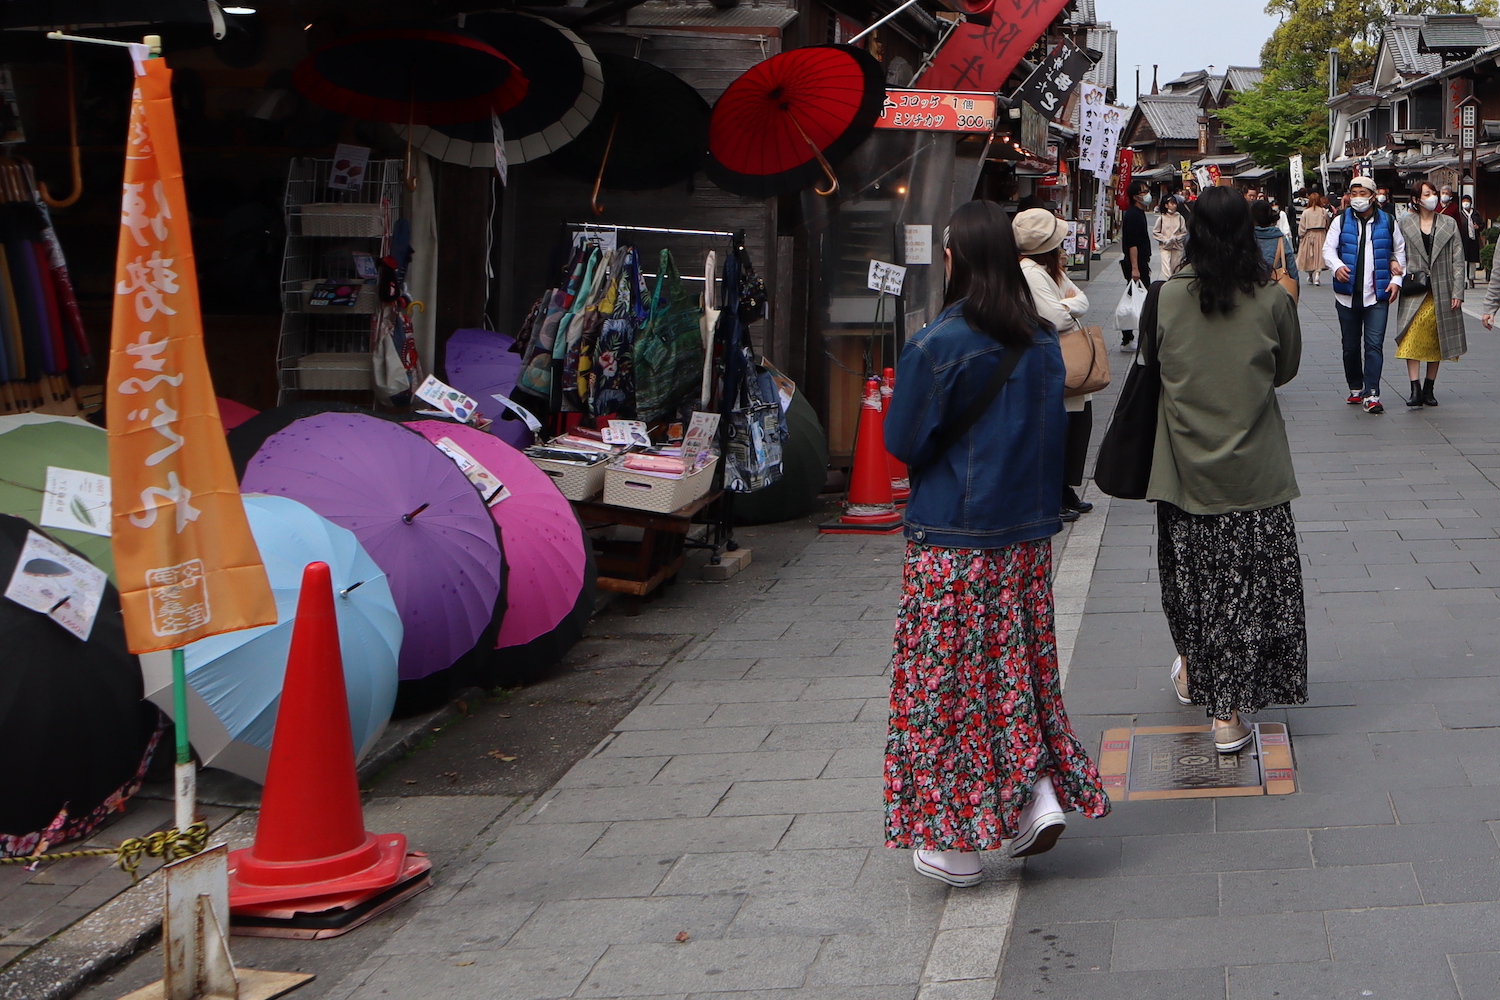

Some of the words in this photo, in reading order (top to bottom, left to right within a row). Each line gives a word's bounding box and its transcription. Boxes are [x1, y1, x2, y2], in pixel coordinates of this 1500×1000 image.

[899, 94, 941, 109] コロッケ
[952, 97, 975, 110] 1個
[893, 112, 946, 127] ミンチカツ
[956, 114, 995, 129] 300円
